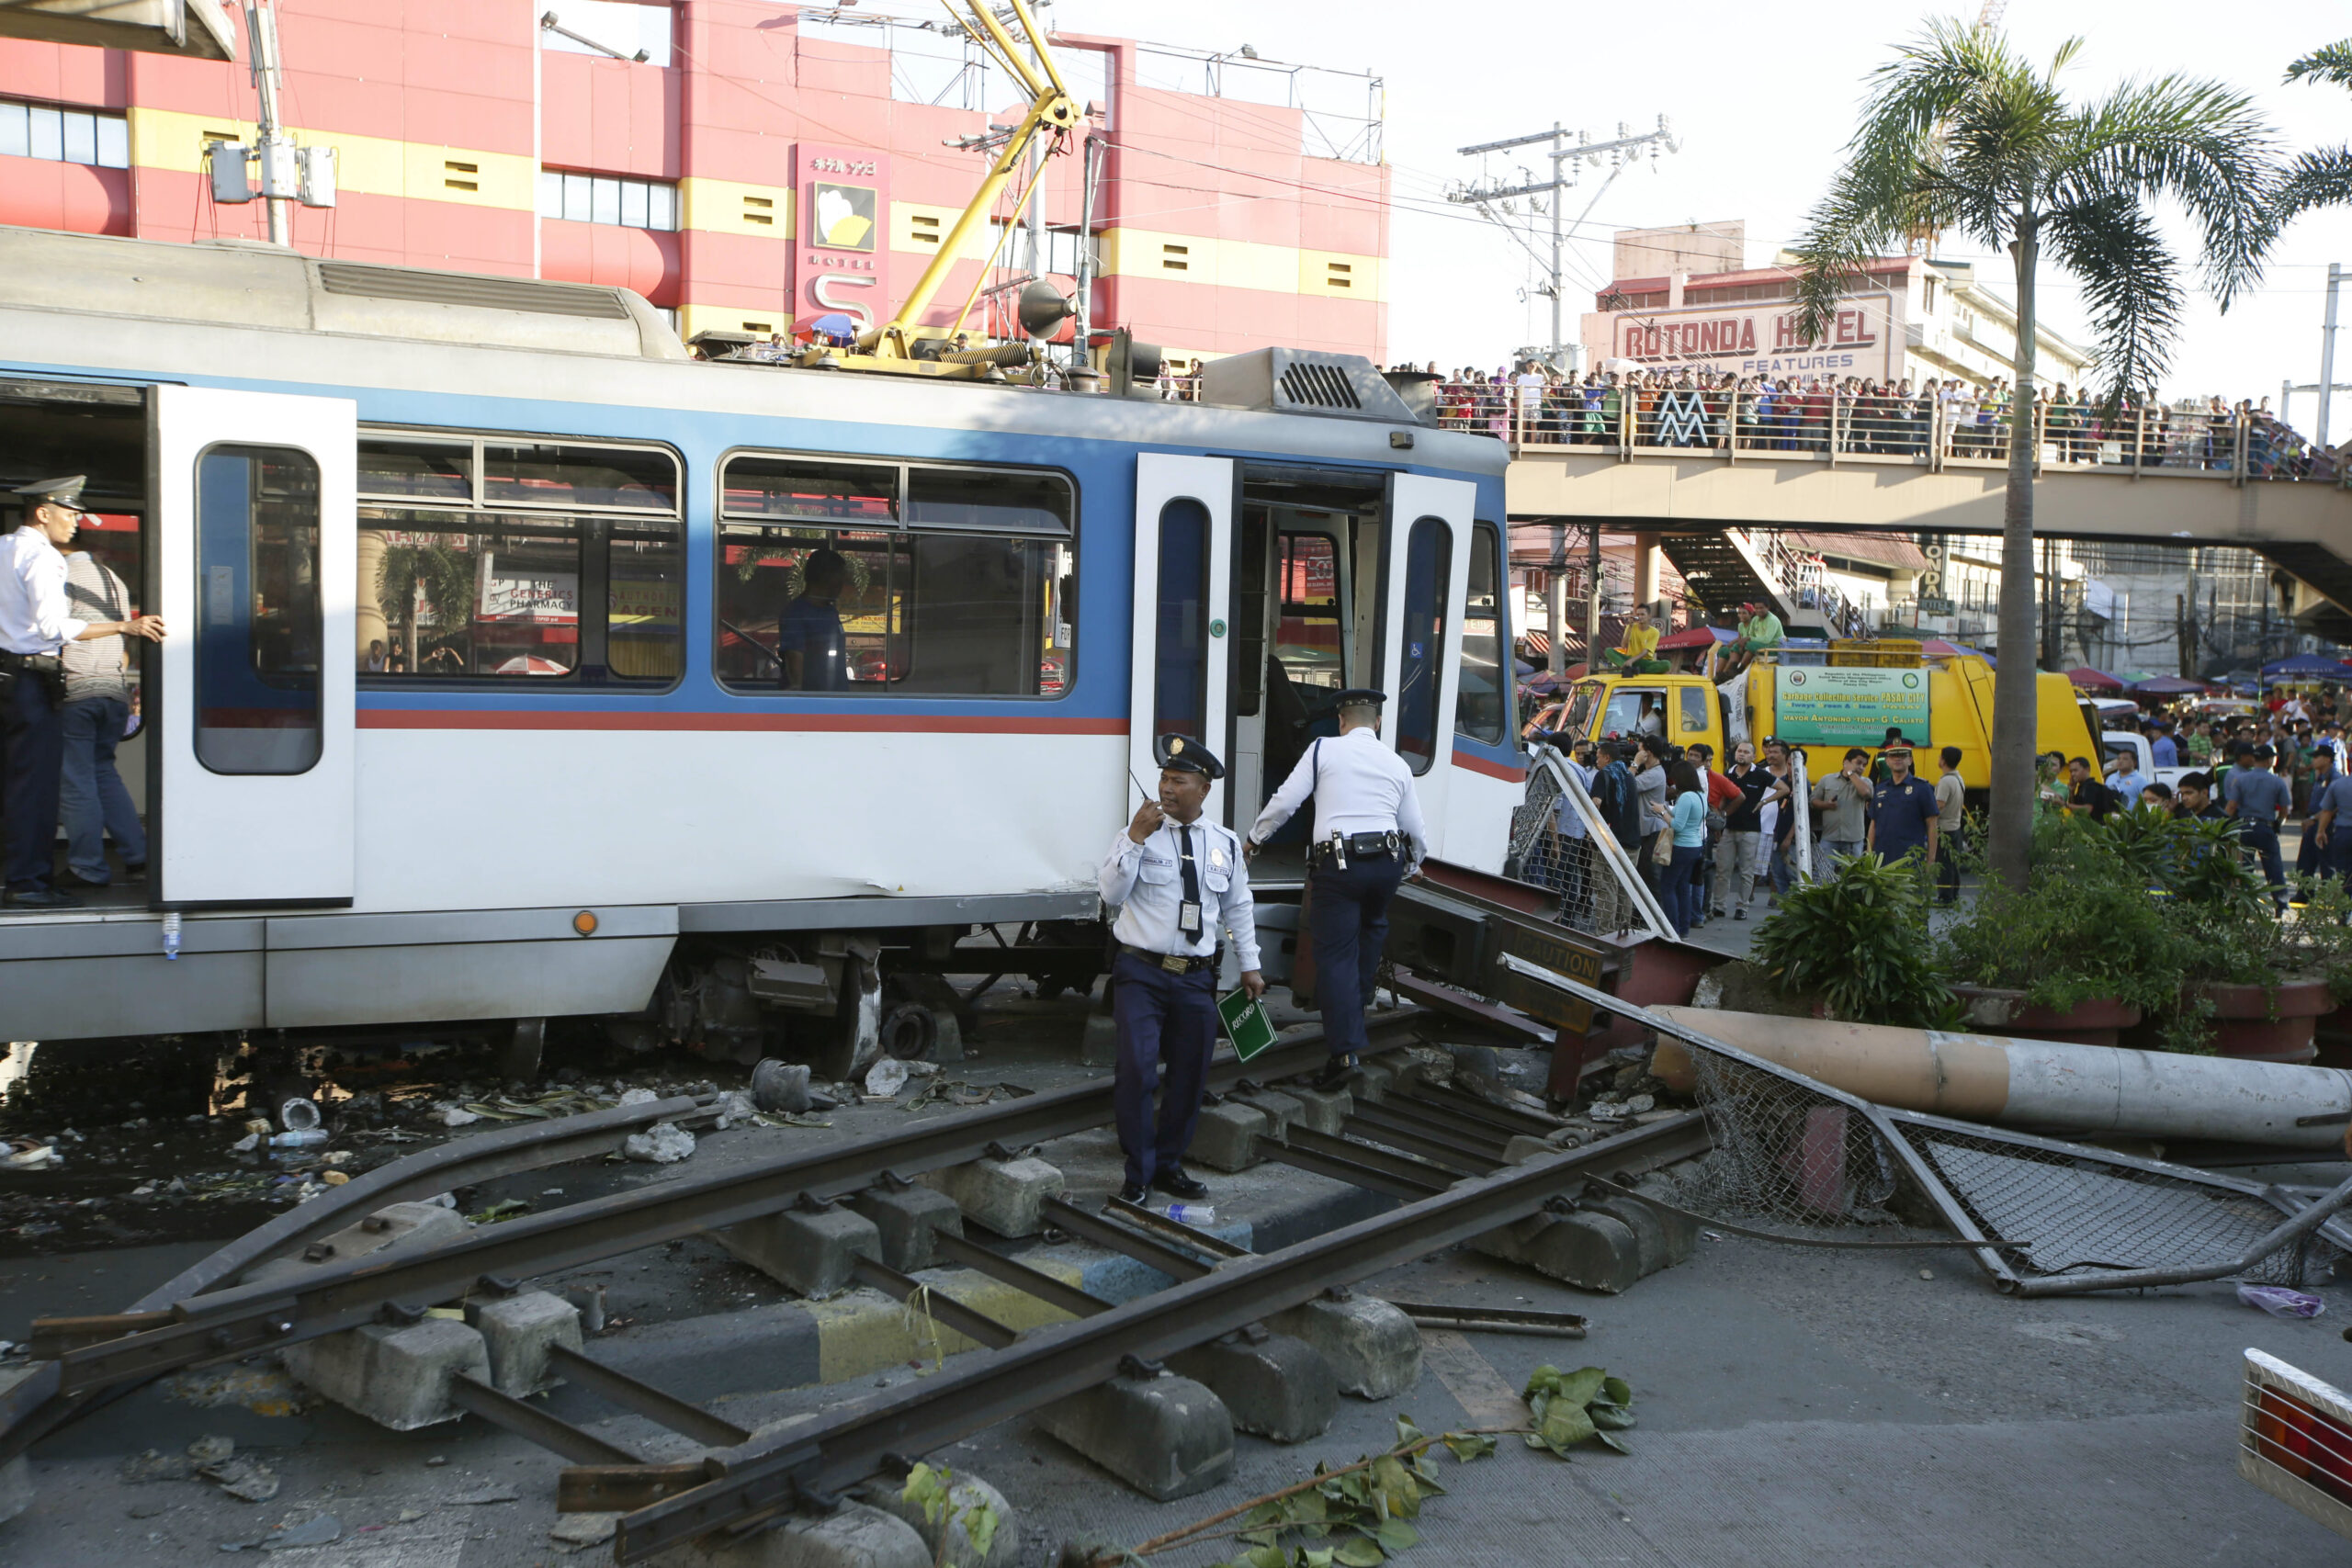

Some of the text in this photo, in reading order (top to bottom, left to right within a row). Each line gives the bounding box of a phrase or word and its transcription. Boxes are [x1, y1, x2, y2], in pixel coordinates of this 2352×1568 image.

[1624, 318, 1758, 361] ROTONDA
[1743, 355, 1853, 373] FEATURES
[530, 581, 555, 589] THE
[510, 589, 573, 600] GENERICS
[510, 599, 573, 610] PHARMACY
[1782, 692, 1925, 704] Garbage Collection Service PASAY CITY
[1521, 935, 1596, 978] CAUTION
[1232, 1003, 1255, 1031] RECORD
